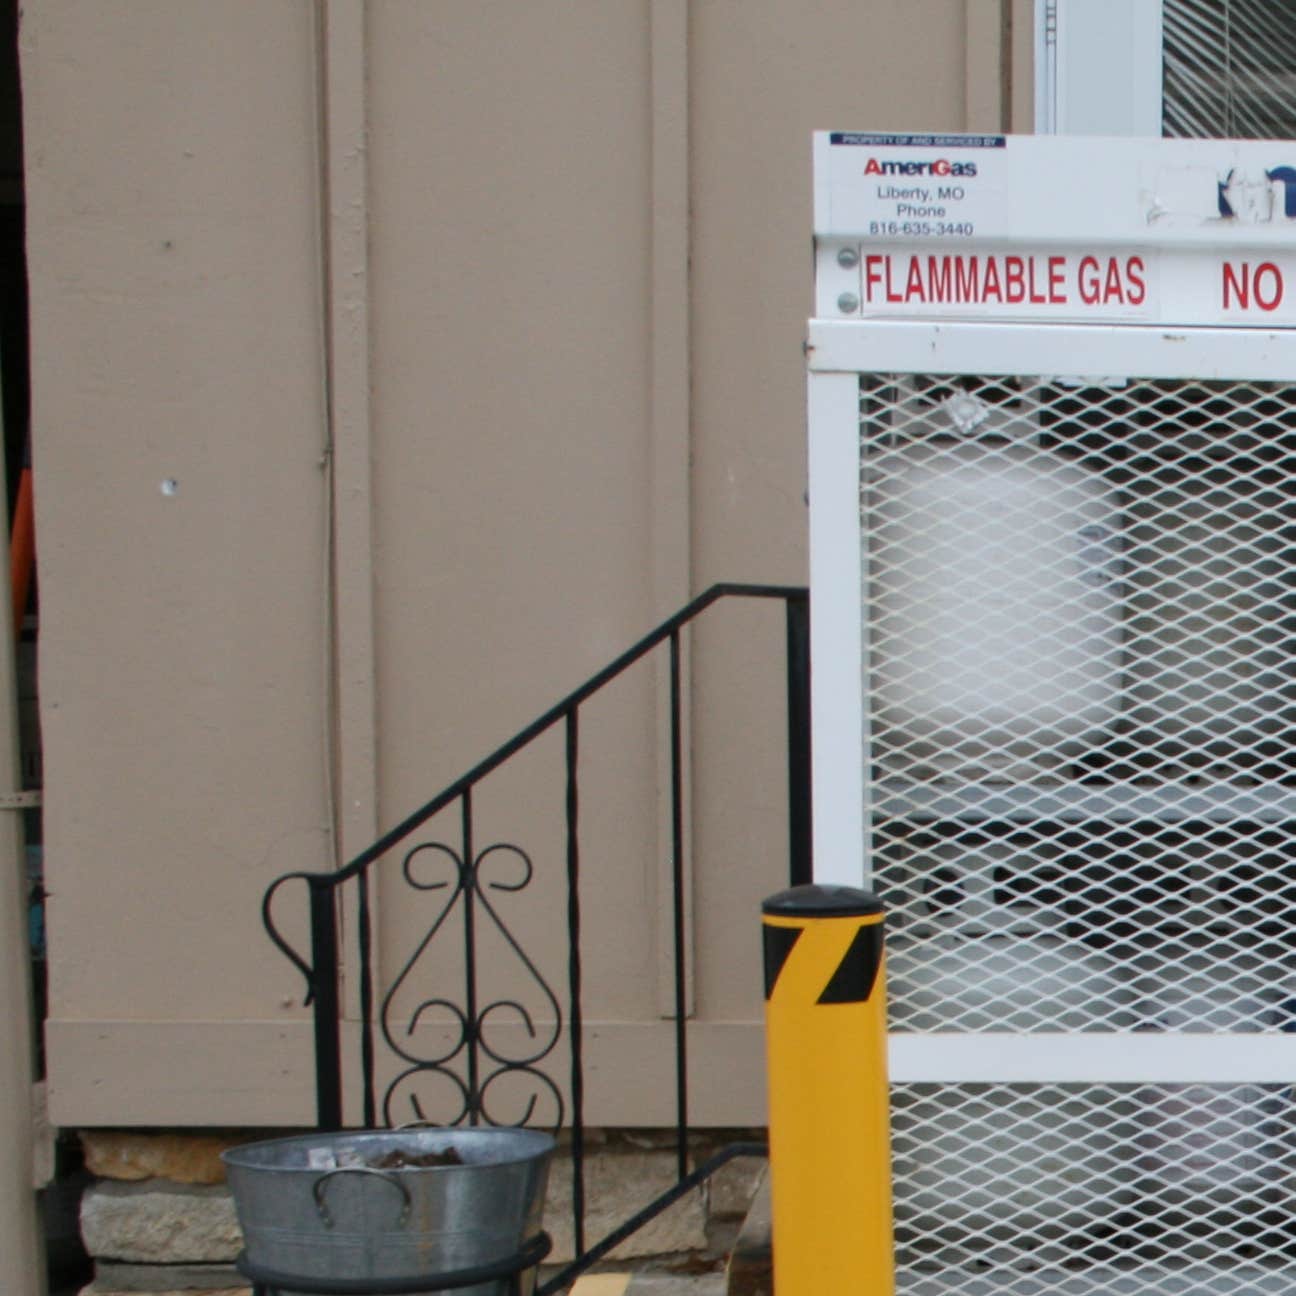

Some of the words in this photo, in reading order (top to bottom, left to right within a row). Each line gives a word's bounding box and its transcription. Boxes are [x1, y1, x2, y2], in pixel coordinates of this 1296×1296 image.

[864, 158, 977, 177] AmeriGas
[877, 186, 933, 202] Liberty,
[938, 186, 965, 200] MO
[897, 203, 946, 217] Phone
[870, 221, 973, 236] 816-635-3440
[866, 255, 1068, 304] FLAMMABLE
[1079, 256, 1146, 306] GAS
[1223, 262, 1284, 312] NO
